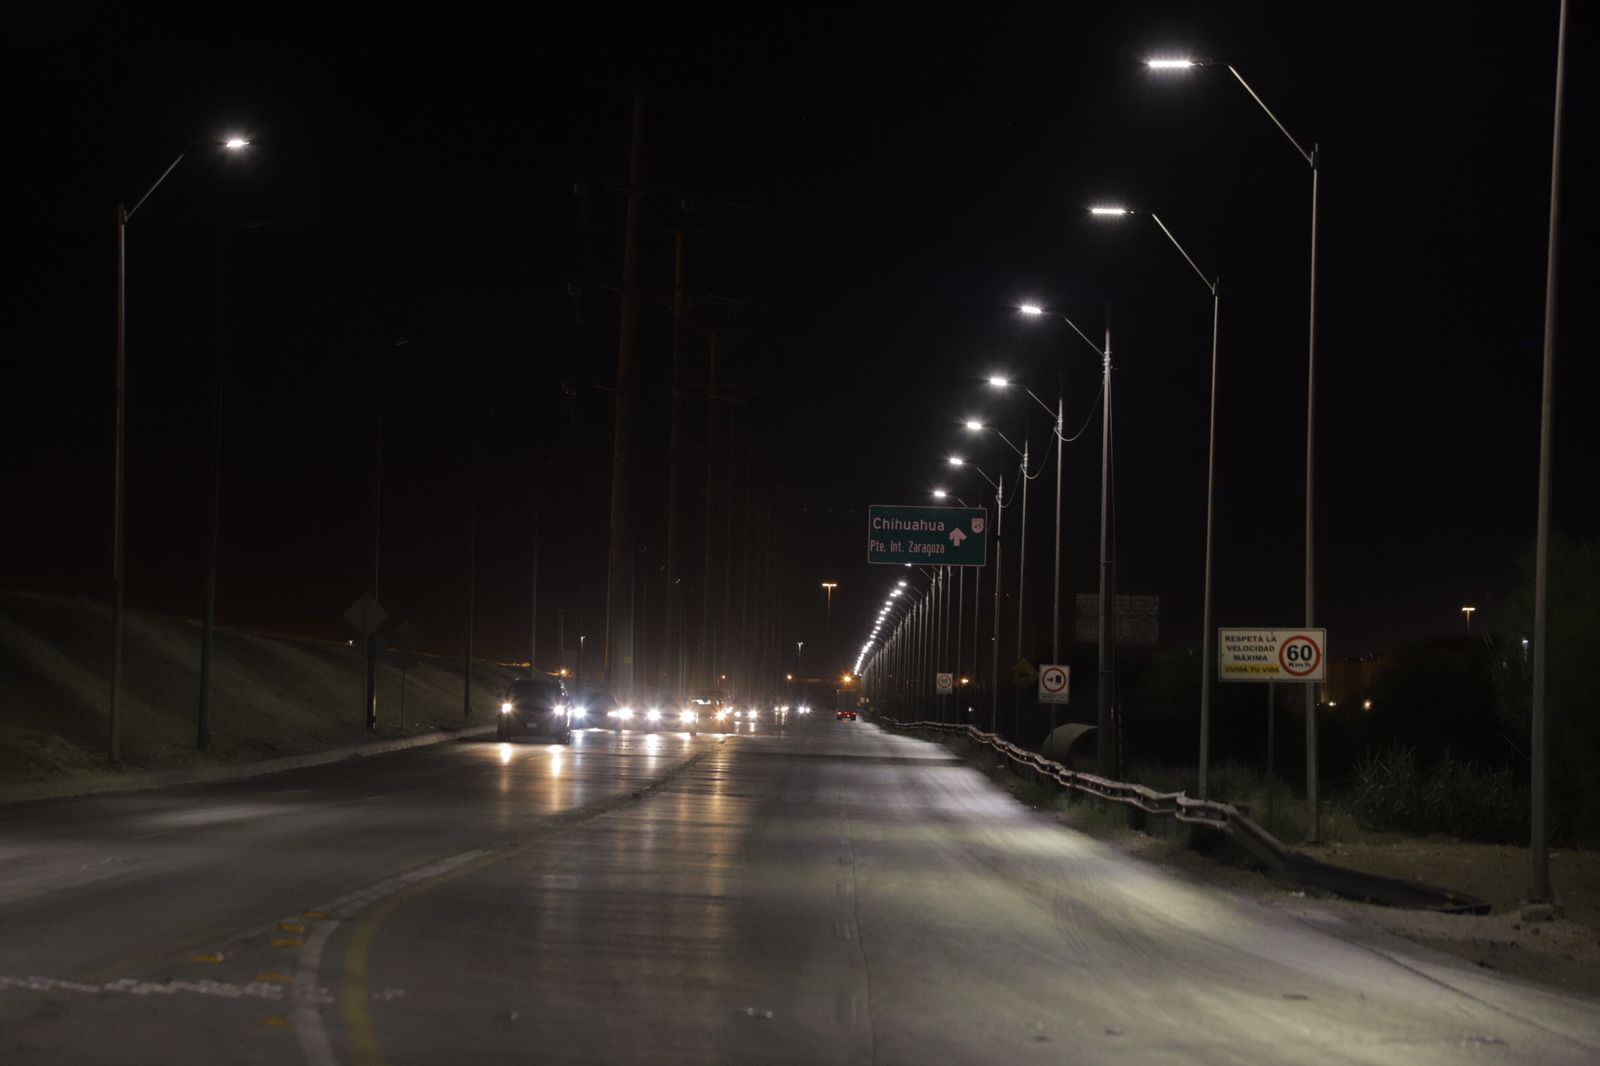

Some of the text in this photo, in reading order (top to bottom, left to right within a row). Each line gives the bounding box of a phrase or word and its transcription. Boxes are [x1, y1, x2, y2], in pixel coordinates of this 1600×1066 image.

[872, 517, 945, 531] Chihuahua
[870, 539, 945, 556] Pte. Int. Zaragoza
[1287, 645, 1312, 661] 60
